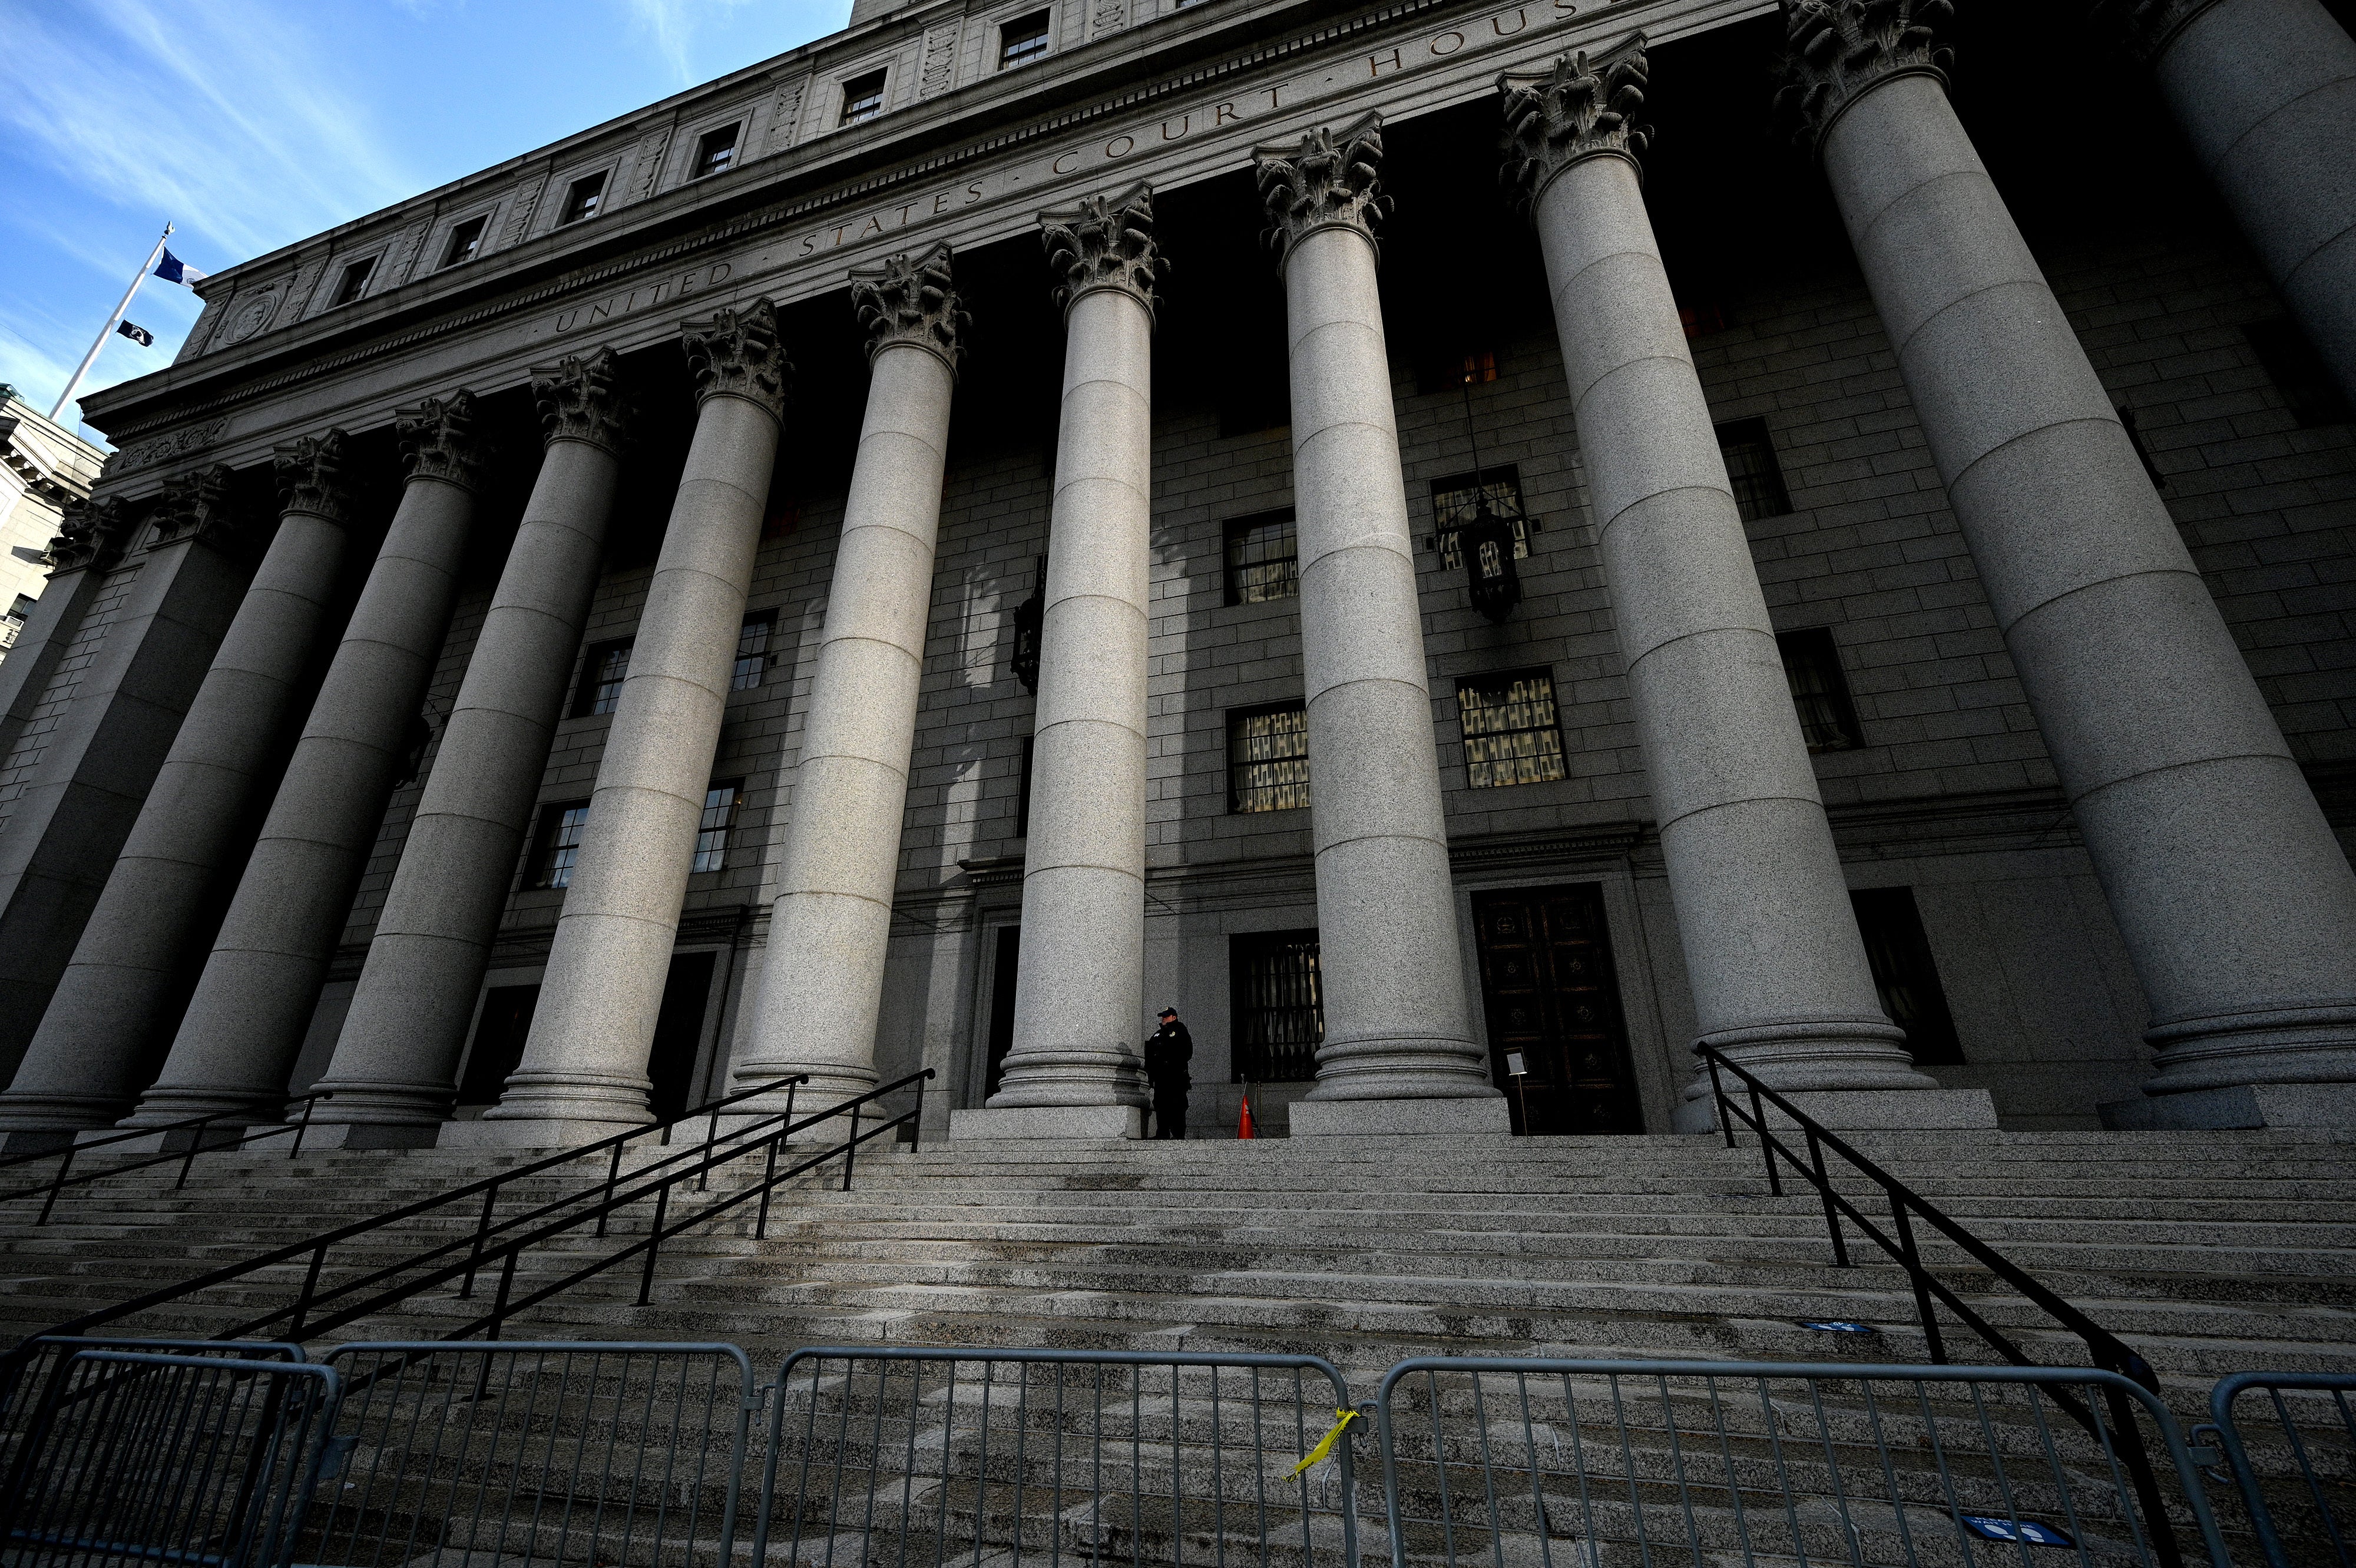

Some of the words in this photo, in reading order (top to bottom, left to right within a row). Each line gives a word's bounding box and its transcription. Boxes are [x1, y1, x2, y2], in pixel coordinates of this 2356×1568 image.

[556, 263, 731, 332] UNITED
[799, 181, 982, 256] STATES
[1053, 84, 1288, 174] COURT
[1368, 0, 1620, 76] HOUS
